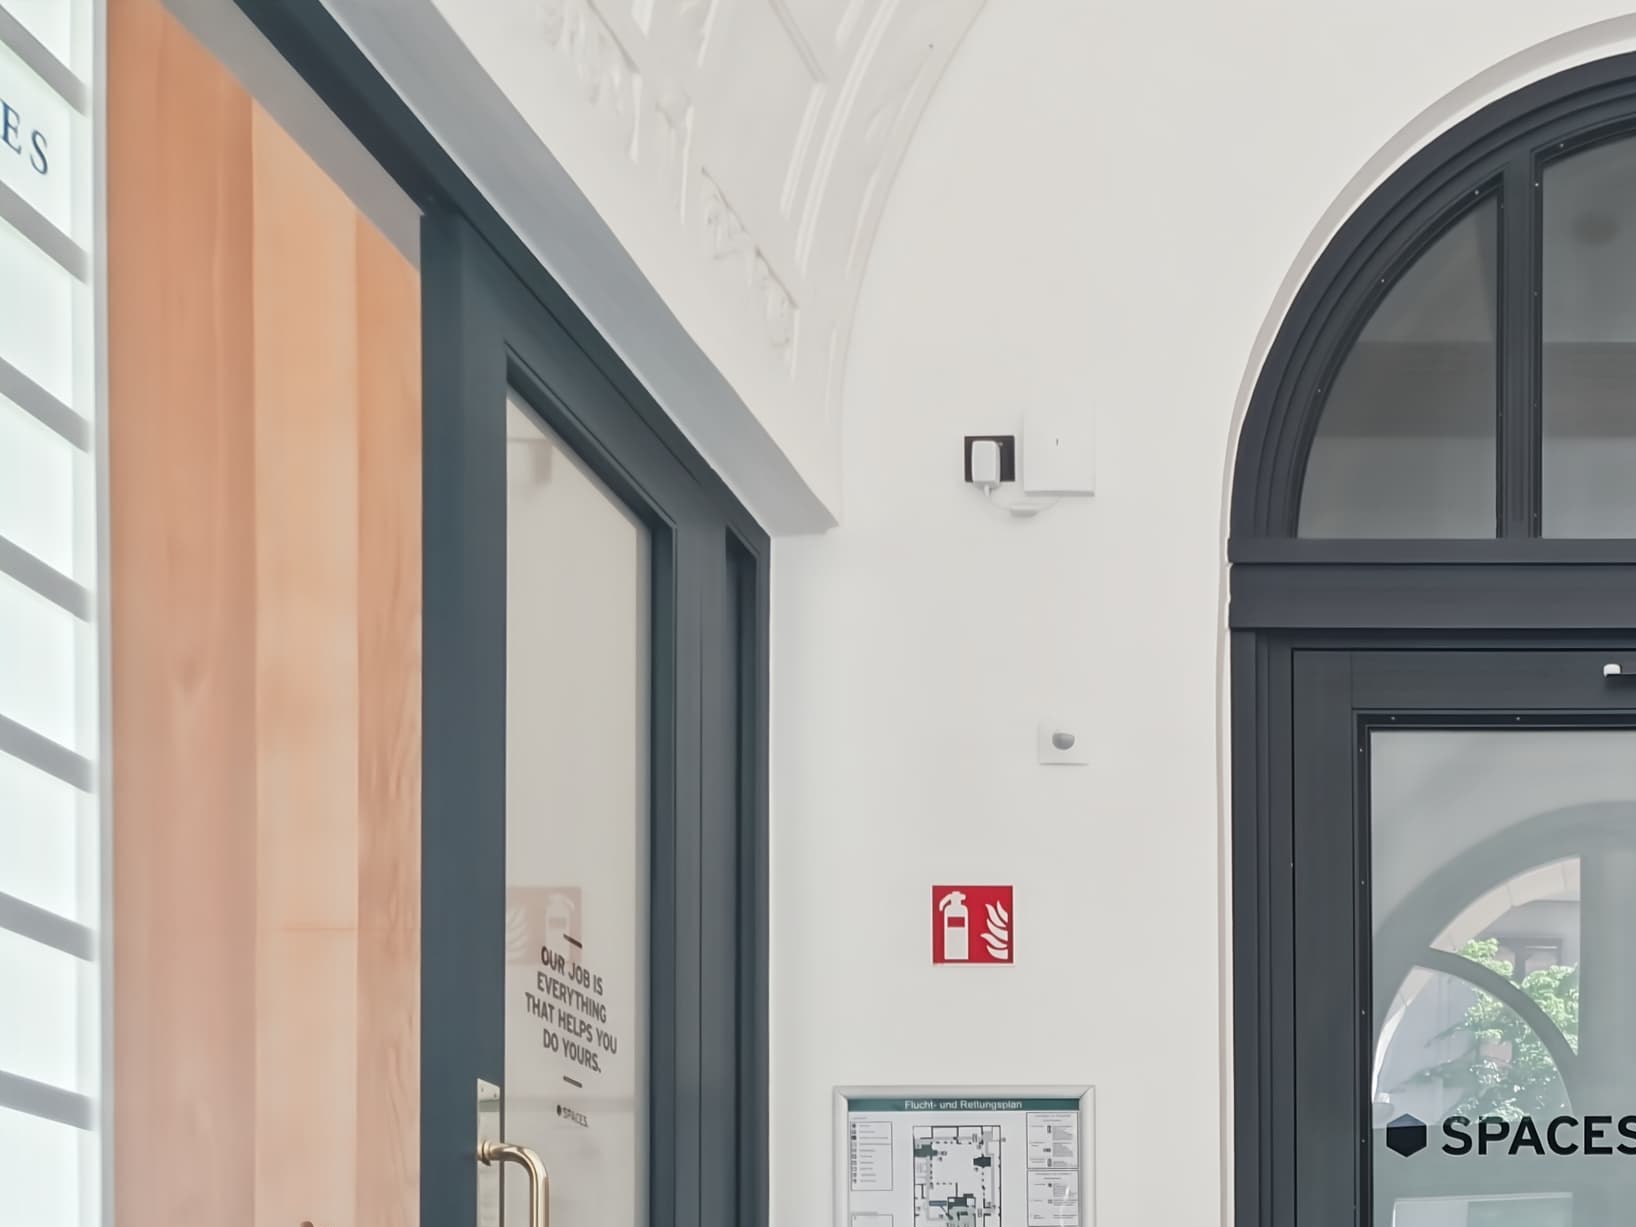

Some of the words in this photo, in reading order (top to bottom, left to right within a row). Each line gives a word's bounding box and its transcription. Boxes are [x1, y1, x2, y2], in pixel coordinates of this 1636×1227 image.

[541, 945, 565, 976] OUR
[568, 962, 590, 989] JOB
[593, 974, 604, 996] IS
[537, 970, 607, 1024] EVERYTHING
[524, 991, 555, 1024] THAT
[558, 1008, 593, 1043] HELPS
[596, 1026, 618, 1055] YOU
[543, 1027, 559, 1053] DO
[562, 1037, 602, 1073] YOURS.
[904, 1099, 937, 1111] Flucht-
[939, 1099, 958, 1110] und
